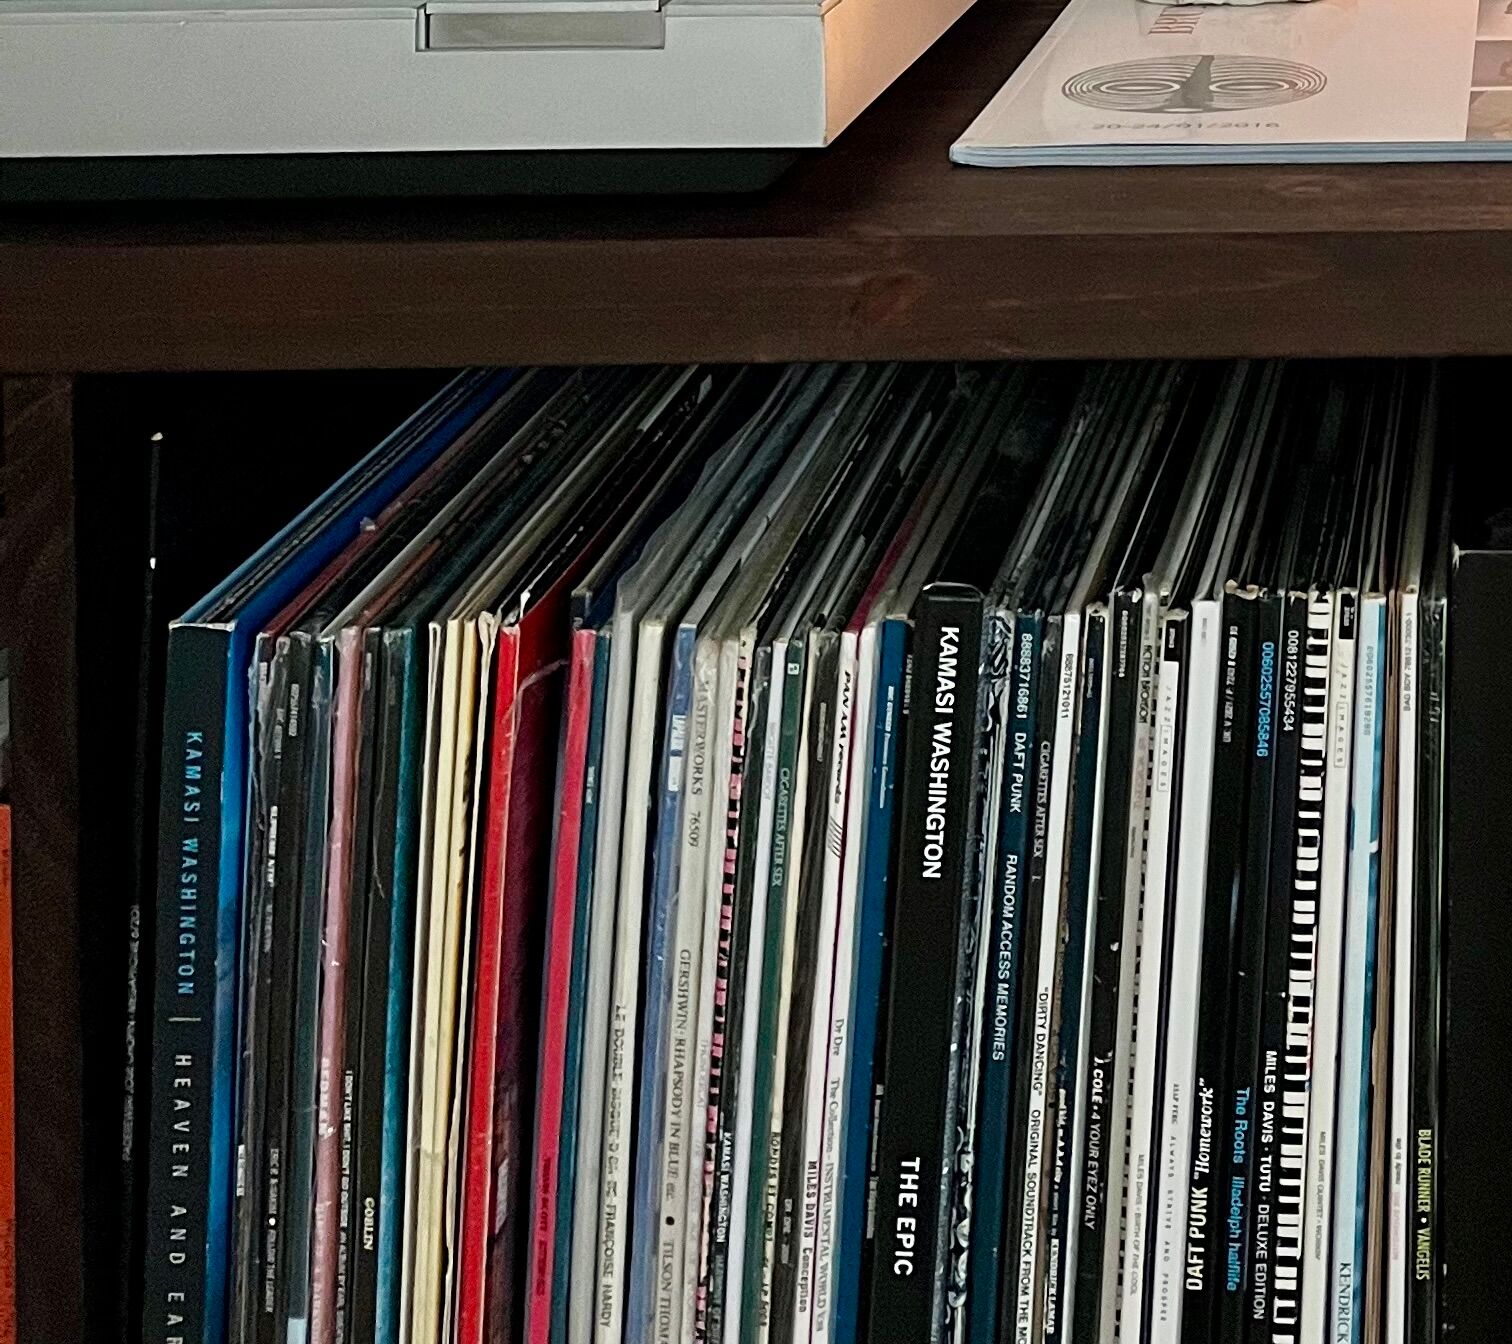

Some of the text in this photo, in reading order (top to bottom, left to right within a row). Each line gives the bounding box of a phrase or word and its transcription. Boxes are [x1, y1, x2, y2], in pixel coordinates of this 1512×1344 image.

[184, 732, 203, 823] KAMASI
[1012, 732, 1027, 770] DAFT
[1009, 773, 1024, 813] PUNK
[1033, 741, 1051, 858] CIGARETTES AFTER SEX
[687, 811, 701, 847] 76509
[772, 767, 790, 887] CIGARETTES AFTER SEX
[1002, 854, 1018, 918] RANDOM
[178, 838, 199, 995] WASHINGTON
[894, 626, 959, 1276] KAMASI WASHINGTON THE EPIC
[998, 921, 1014, 979] ACCESS
[1252, 630, 1299, 1320] 0081227955434 MILES DAVIS TUTU DELUXE EDITION
[993, 983, 1009, 1061] MEMORIES
[669, 1037, 685, 1119] RHAPSODY
[830, 1077, 841, 1098] The
[1235, 1087, 1250, 1115] The
[172, 1054, 191, 1177] HEAVEN
[670, 1122, 682, 1138] IN
[1028, 1109, 1041, 1170] ORIGINAL
[1233, 1119, 1248, 1163] Roots
[667, 1141, 680, 1179] BLUE
[1084, 1069, 1104, 1231] COLE 4 YOUR EYEZ ONLY
[806, 1160, 819, 1199] MILES
[1416, 1129, 1432, 1280] BLADE RUNNER VANGELIS
[169, 1205, 187, 1264] AND
[363, 1197, 375, 1250] GOBLIN
[716, 1174, 730, 1243] WASHINGTON
[804, 1203, 816, 1238] DAVIS
[819, 1163, 835, 1261] INSTRUMENTAL
[1022, 1172, 1038, 1258] SOUNDTRACK
[1188, 1186, 1208, 1239] PUNK
[661, 1240, 674, 1292] TILSON
[816, 1263, 830, 1309] WORLD
[1019, 1261, 1032, 1297] FROM
[1186, 1242, 1204, 1290] DAFT
[1226, 1242, 1241, 1291] halflife
[600, 1284, 612, 1328] HARDY
[1018, 1299, 1030, 1323] THE
[1337, 1262, 1352, 1344] KENDRICK
